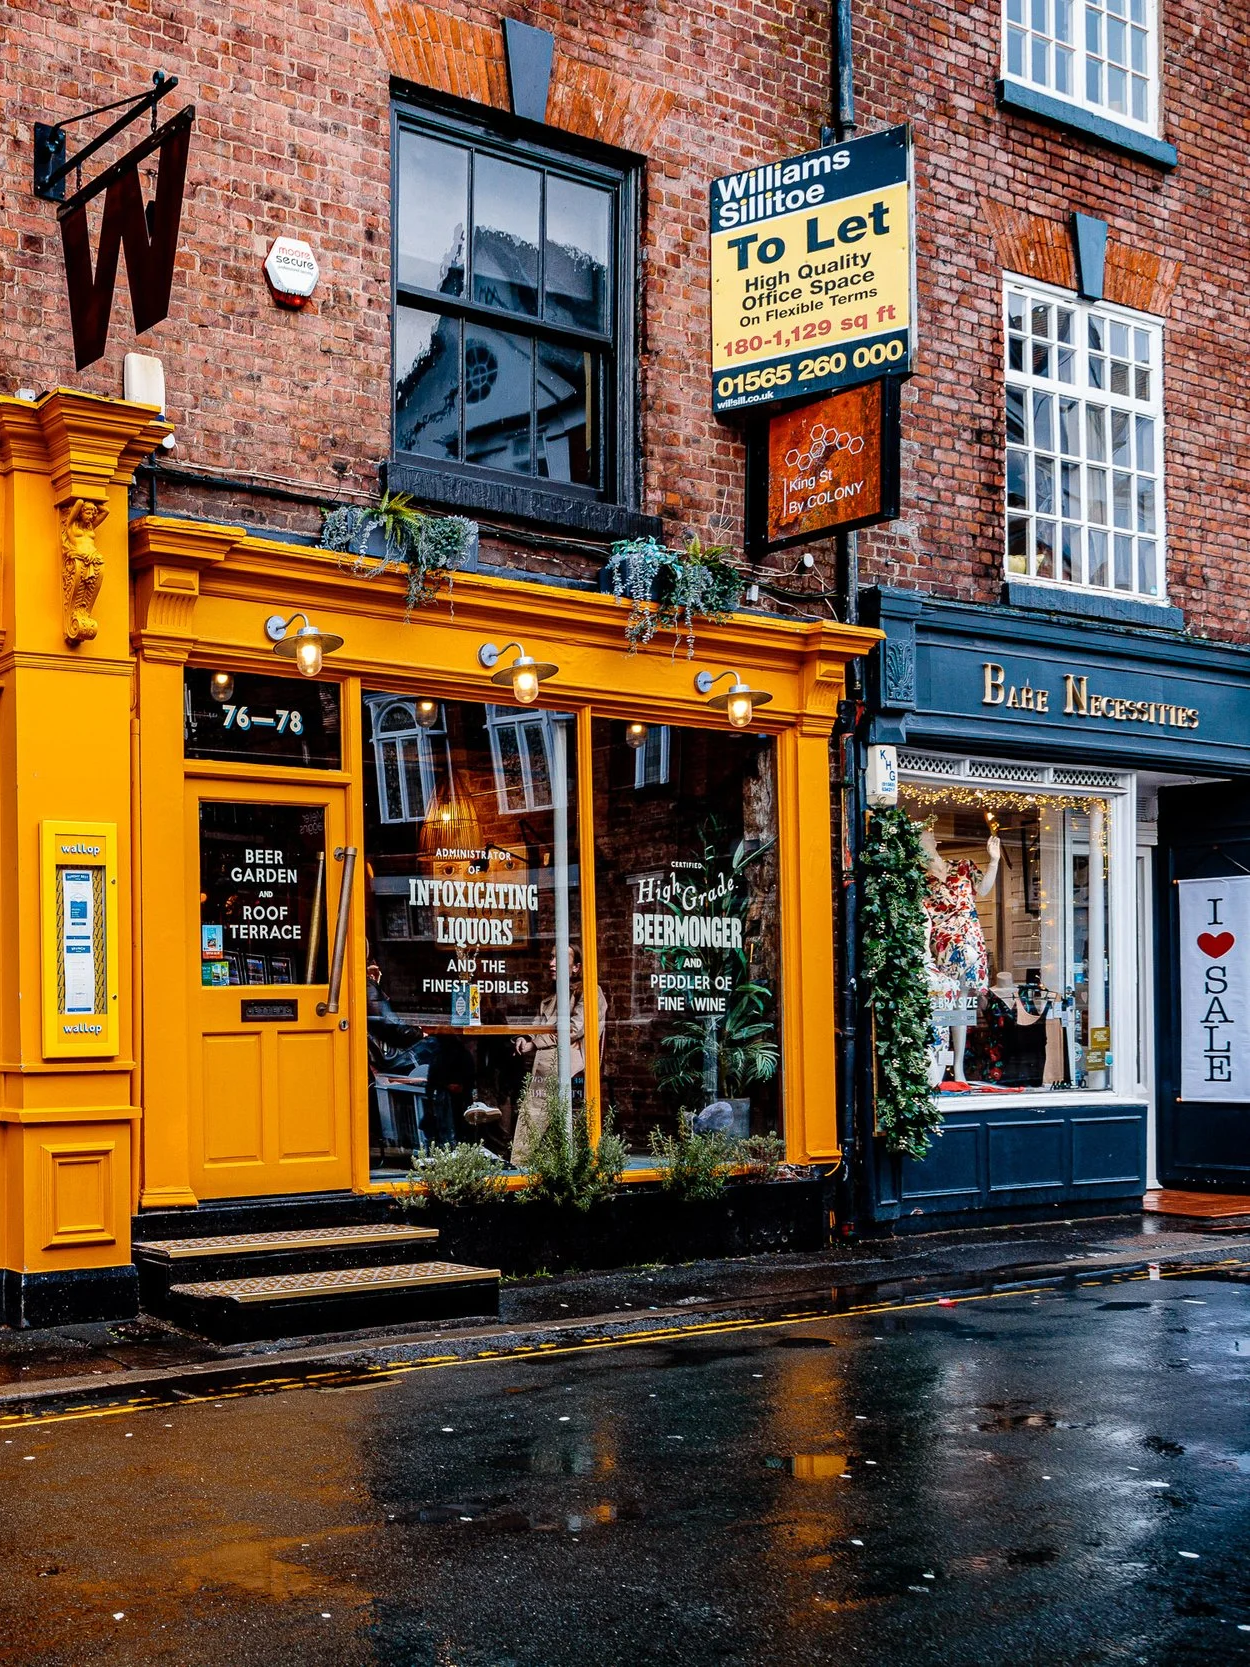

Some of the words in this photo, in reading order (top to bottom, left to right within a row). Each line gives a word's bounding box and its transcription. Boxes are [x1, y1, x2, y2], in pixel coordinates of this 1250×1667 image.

[717, 149, 851, 203] Williams
[718, 182, 825, 228] Sillitoe
[727, 233, 786, 271] To
[806, 201, 890, 254] Let
[275, 255, 314, 270] secure
[278, 247, 311, 260] moore
[745, 270, 790, 293] High
[798, 252, 872, 280] Quality
[742, 286, 803, 311] Office
[810, 270, 875, 296] Space
[739, 316, 760, 328] On
[766, 299, 824, 323] Flexible
[829, 287, 878, 307] Terms
[723, 318, 832, 358] 180-1,129
[840, 313, 868, 331] sq
[876, 304, 896, 323] ft
[717, 363, 792, 397] 01565
[798, 352, 847, 381] 260
[852, 339, 904, 369] 000
[789, 475, 816, 493] King
[819, 468, 833, 483] St
[788, 501, 804, 515] By
[806, 480, 864, 509] COLONY
[61, 844, 101, 857] wallop
[245, 849, 284, 865] BEER
[435, 848, 512, 861] ADMINISTRATOR
[230, 867, 298, 884] GARDEN
[467, 865, 481, 875] OF
[670, 861, 703, 869] CERTIFIED
[408, 878, 539, 912] INTOXICATING
[636, 871, 681, 904] High
[242, 906, 289, 921] ROOF
[1207, 898, 1223, 925] I
[229, 924, 302, 939] TERRACE
[436, 916, 513, 948] LIQUORS
[632, 912, 743, 949] BEERMONGER
[446, 959, 477, 973] AND
[481, 960, 506, 973] THE
[682, 958, 703, 969] AND
[422, 979, 468, 993] FINEST
[477, 980, 529, 994] EDIBLES
[650, 974, 711, 990] PEDDLER
[714, 976, 733, 992] OF
[657, 996, 685, 1011] FINE
[694, 997, 726, 1012] WINE
[62, 1022, 102, 1035] wallop
[1200, 966, 1235, 1082] SALE
